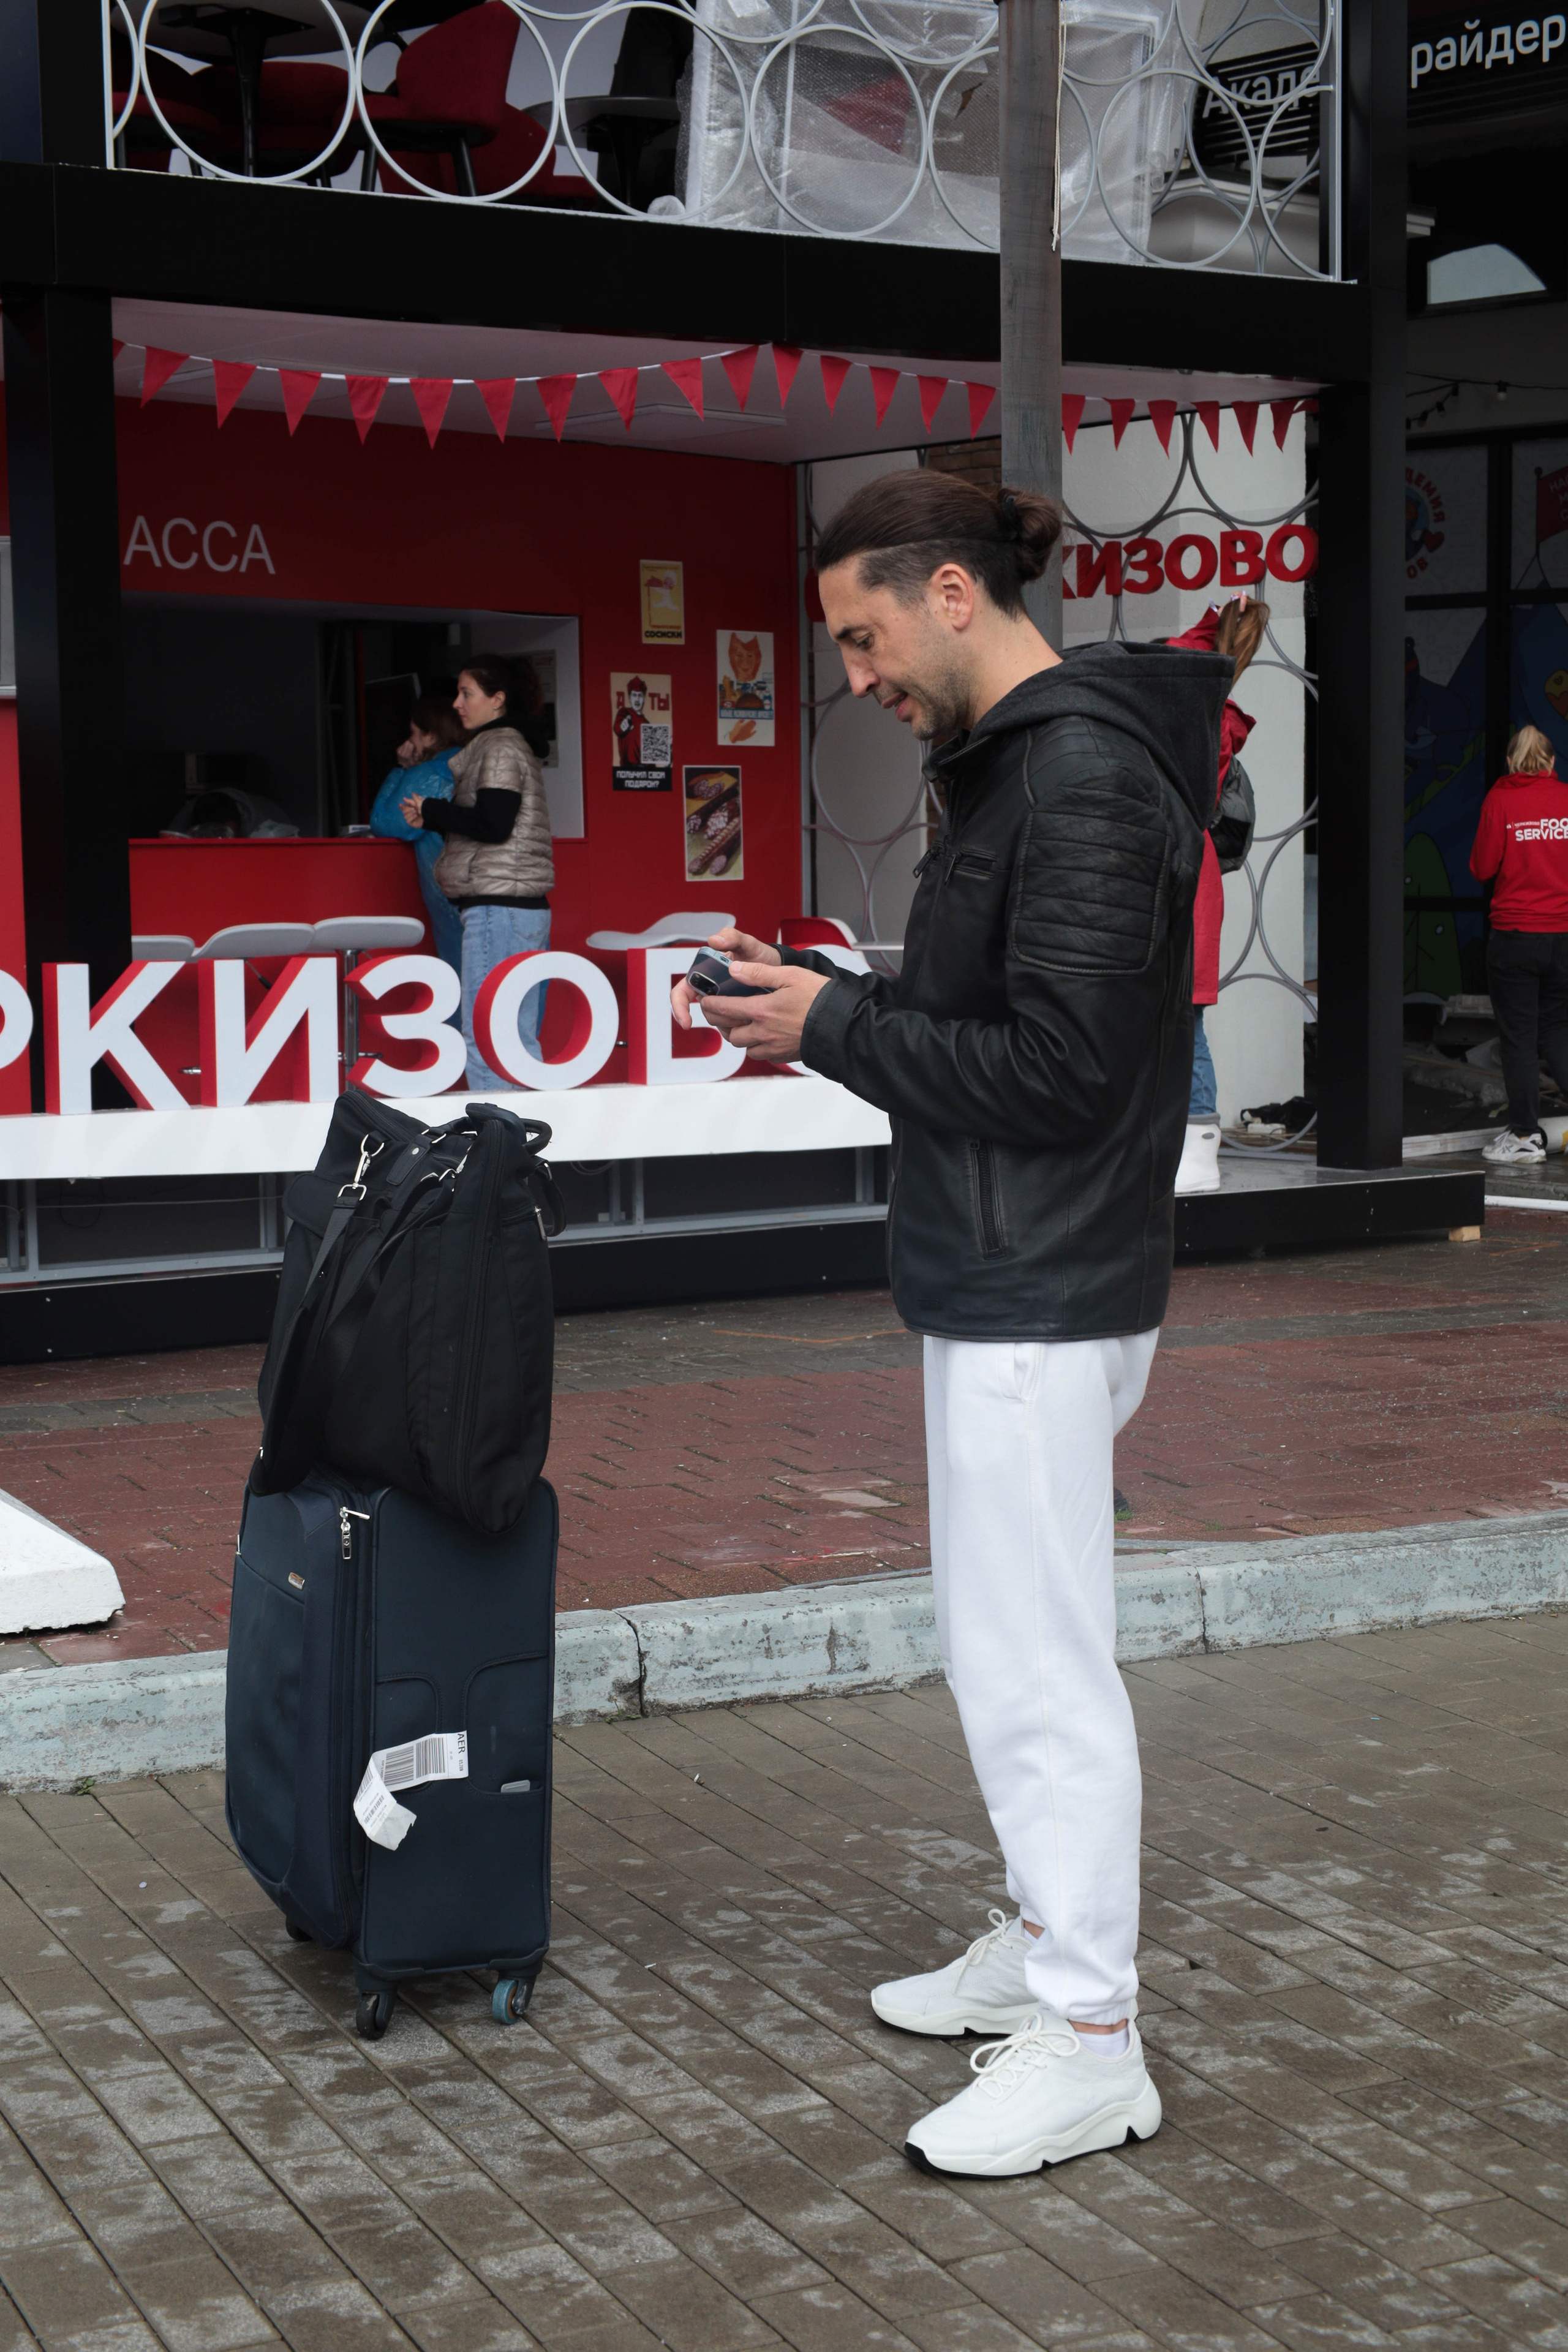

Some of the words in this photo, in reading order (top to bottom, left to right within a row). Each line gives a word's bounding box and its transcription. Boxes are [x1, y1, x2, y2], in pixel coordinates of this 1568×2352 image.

[123, 514, 276, 575] АССА
[644, 630, 682, 639] СОСИСКИ
[616, 691, 625, 709] А
[648, 692, 670, 711] ТЫ
[616, 771, 646, 779] ПОЛУЧИЛ
[457, 1733, 466, 1754] AER
